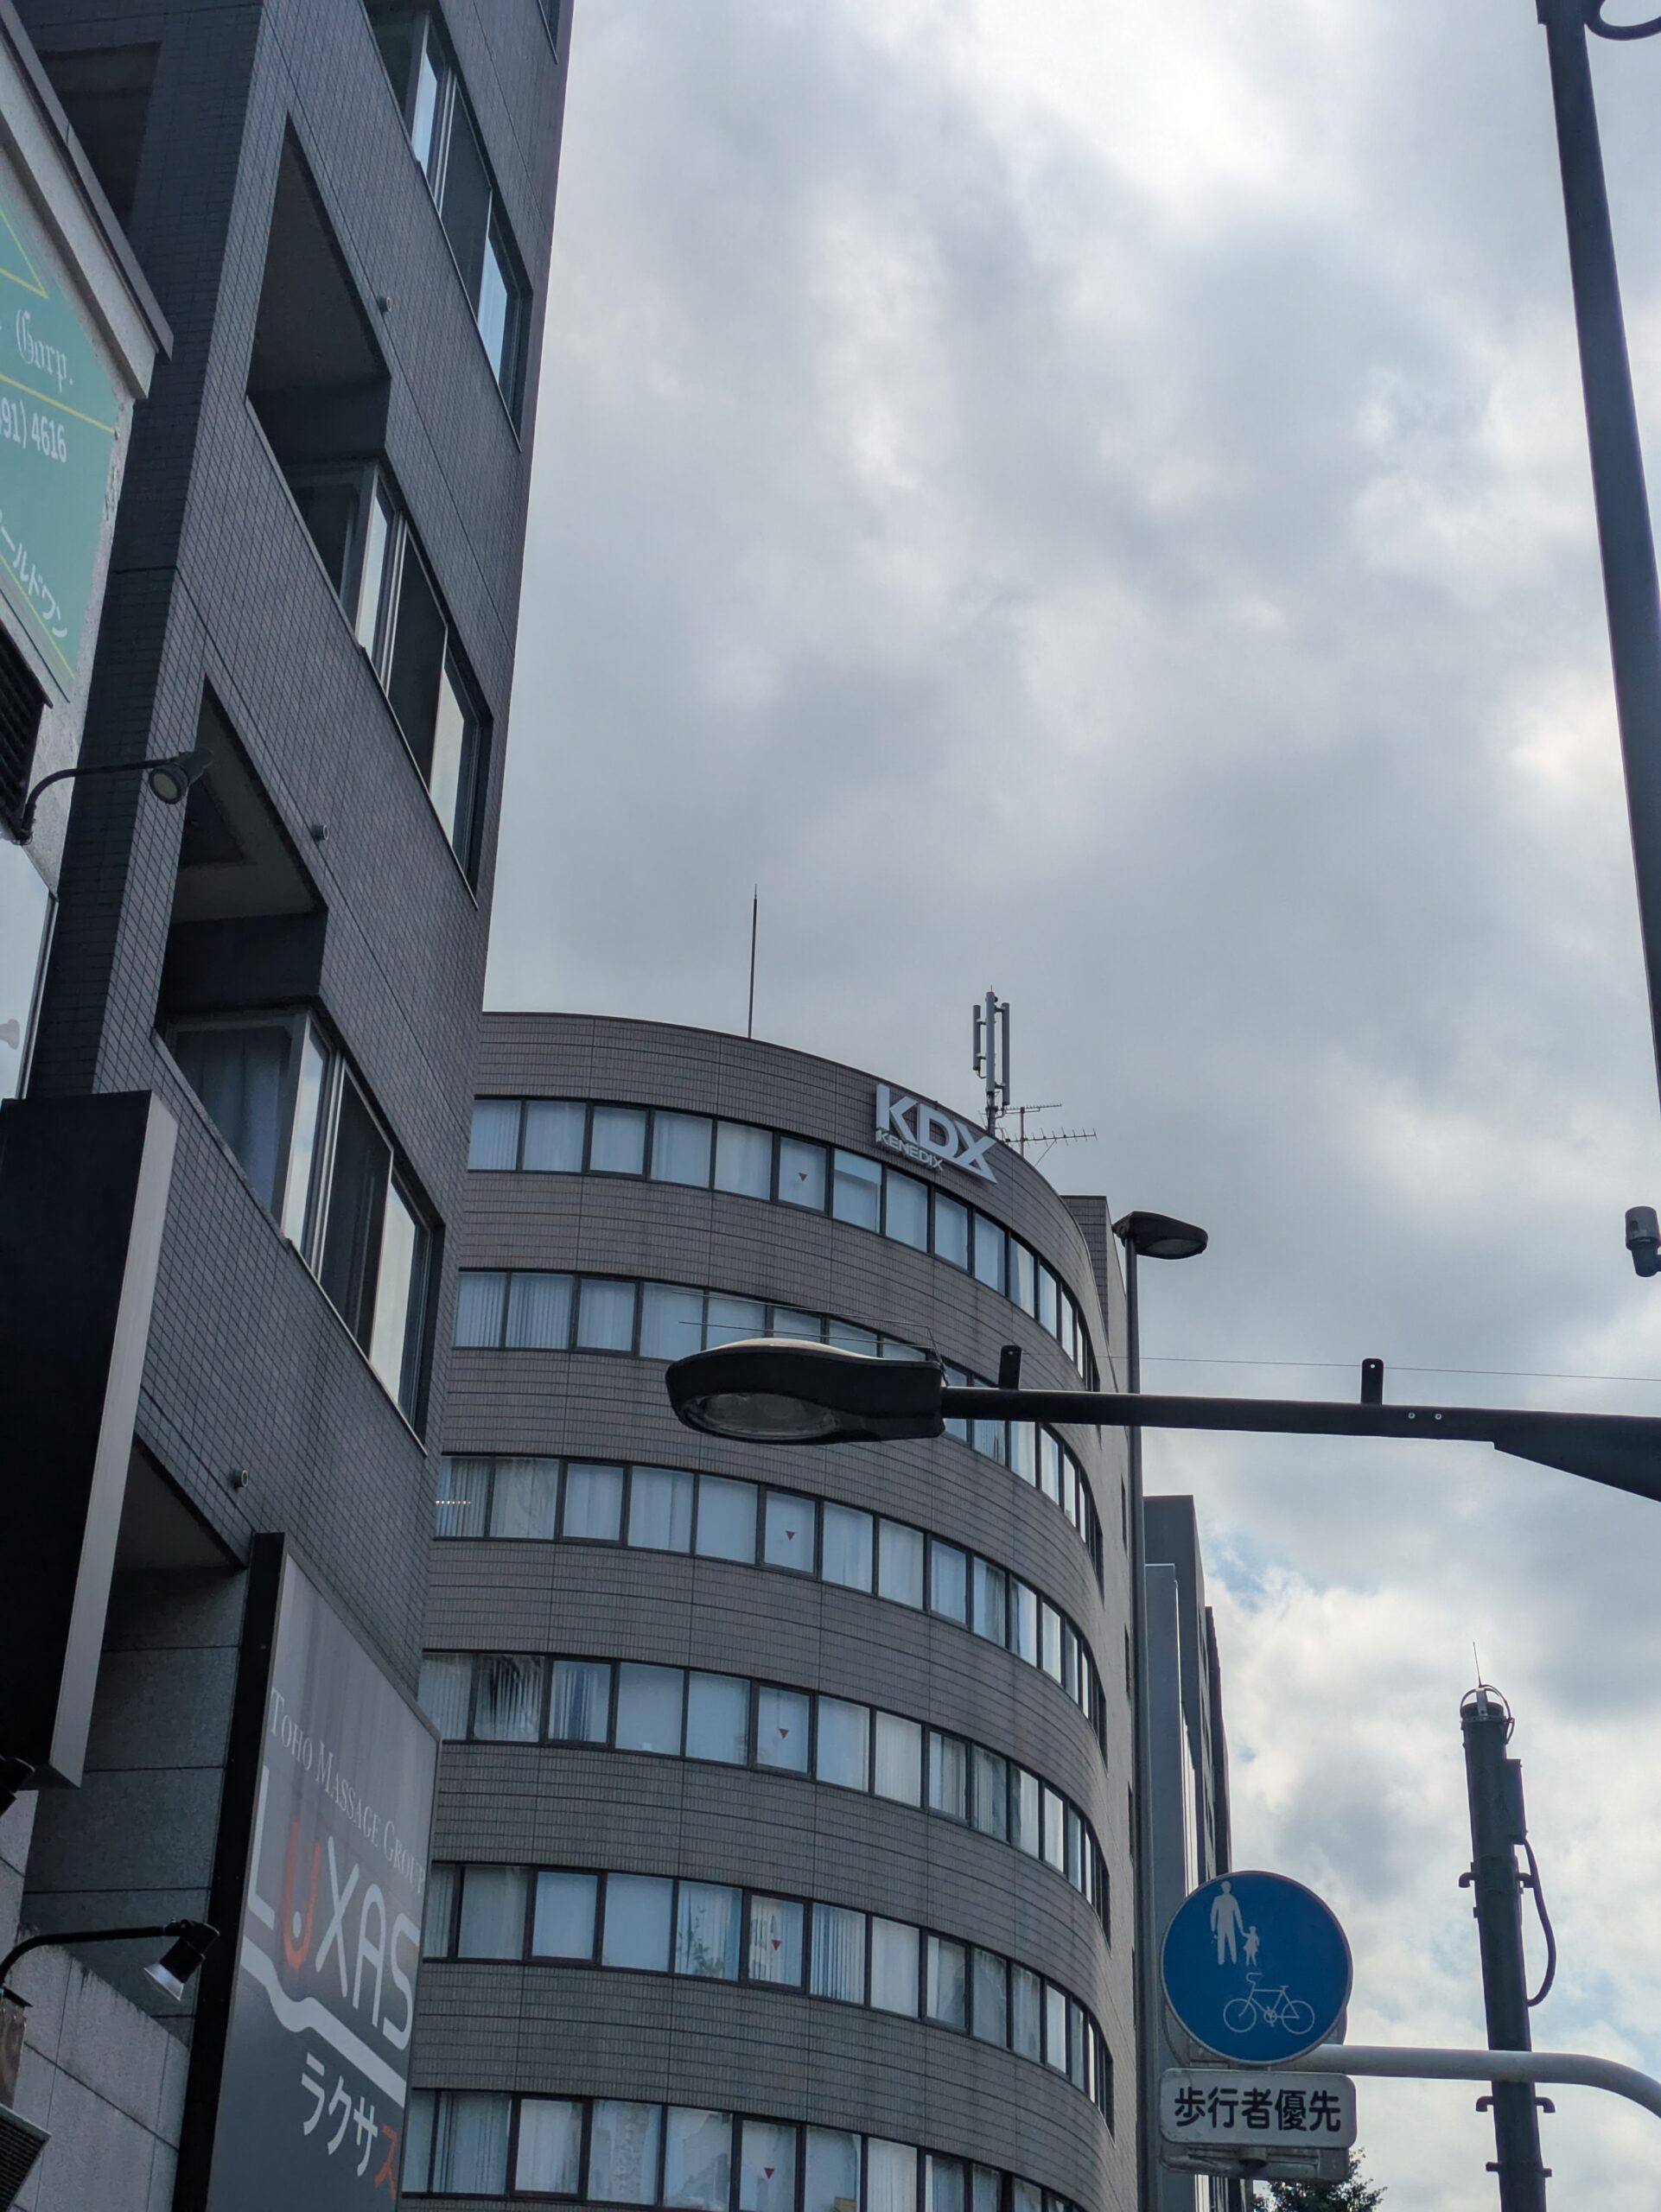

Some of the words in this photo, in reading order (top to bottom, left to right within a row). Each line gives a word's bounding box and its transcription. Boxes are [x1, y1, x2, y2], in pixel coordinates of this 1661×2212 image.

[16, 308, 73, 393] Corp.
[0, 397, 28, 449] 91)
[31, 412, 67, 463] 4616
[0, 509, 67, 638] ールドワン
[875, 1129, 944, 1172] KENEDIX
[876, 1084, 997, 1184] KDX
[270, 1687, 313, 1770] TOHO
[315, 1741, 381, 1847] MASSAGE
[384, 1820, 425, 1894] GROUP
[247, 1765, 420, 2051] LUXAS
[301, 2052, 398, 2200] ラクサス
[1174, 2087, 1341, 2133] 歩行者優先
